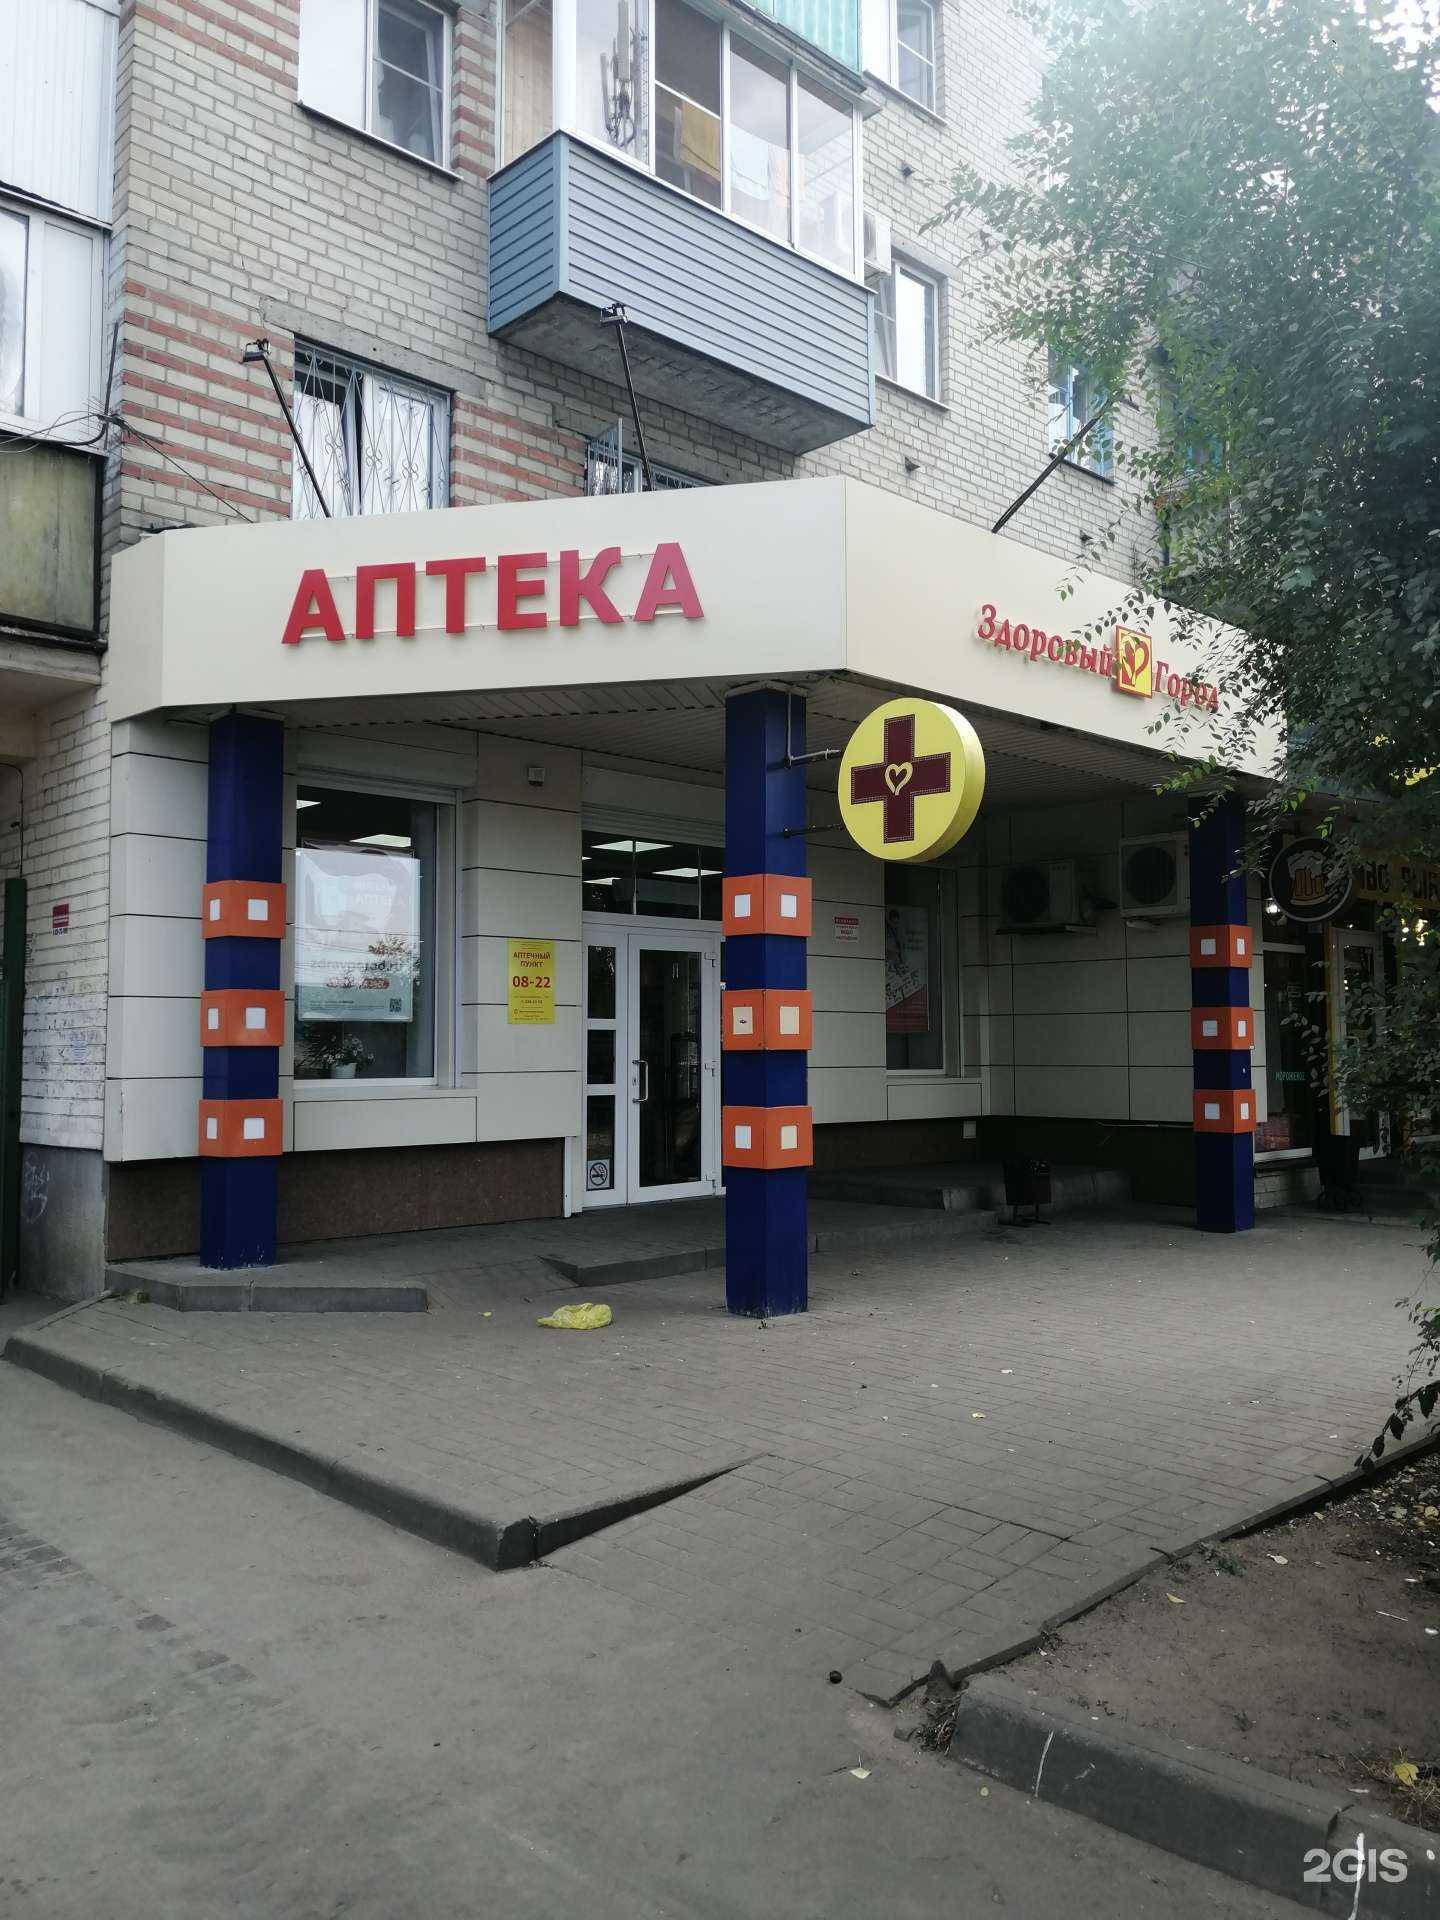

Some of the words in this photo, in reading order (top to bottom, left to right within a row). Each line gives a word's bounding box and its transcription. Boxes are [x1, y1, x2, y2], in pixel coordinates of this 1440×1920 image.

[282, 542, 705, 644] АПТЕКА
[977, 603, 1114, 678] Здоровый
[1154, 660, 1219, 713] Город
[513, 951, 551, 960] АПТЕЧНЫЙ
[520, 960, 544, 968] ПУНКТ
[512, 975, 551, 989] 08-22
